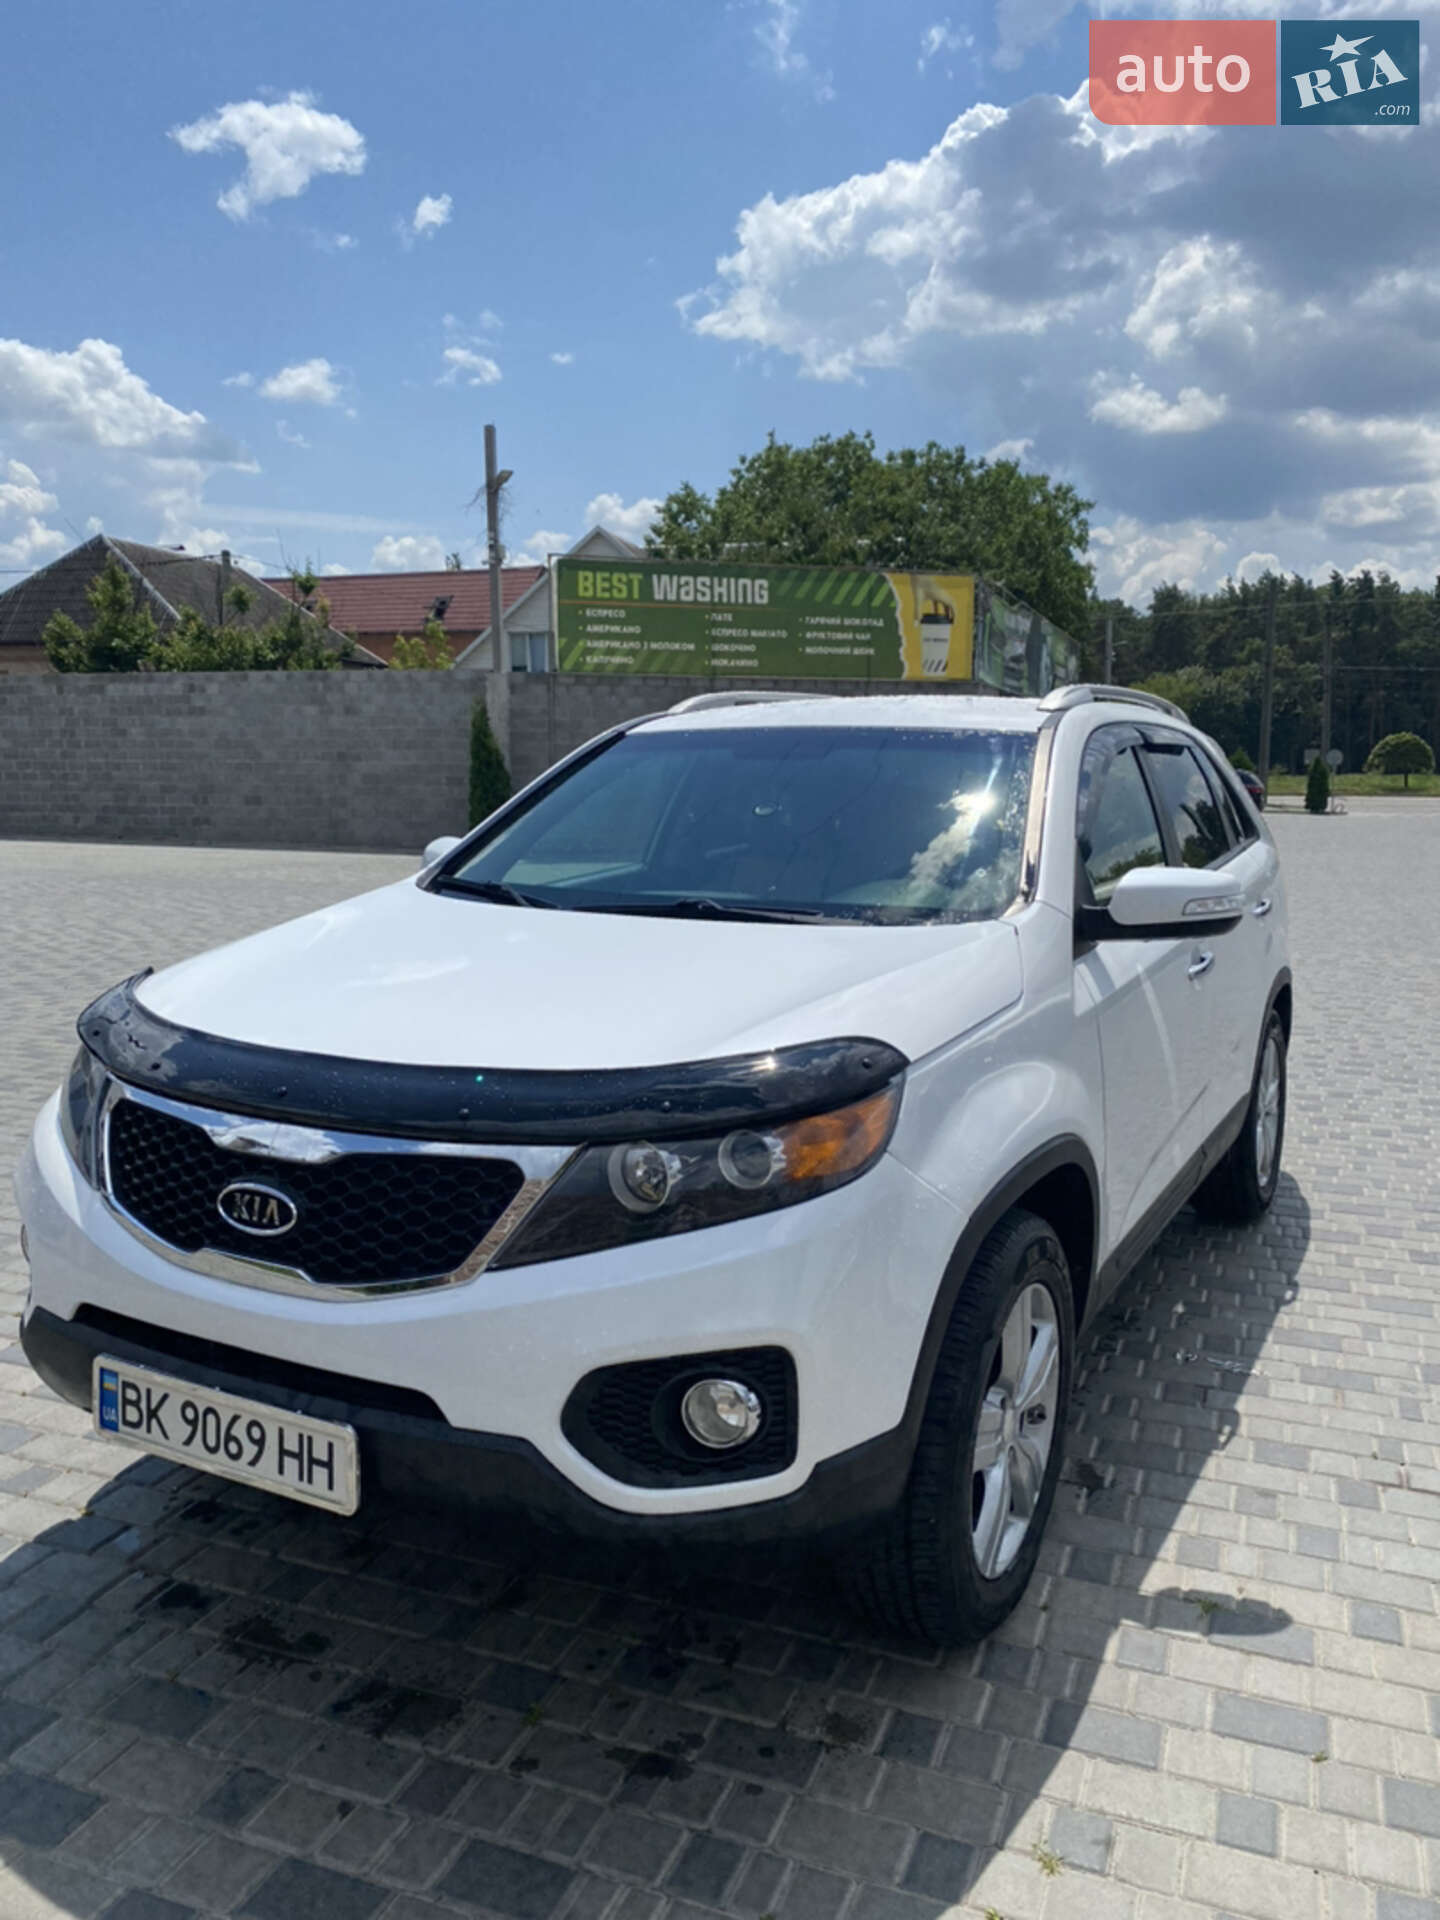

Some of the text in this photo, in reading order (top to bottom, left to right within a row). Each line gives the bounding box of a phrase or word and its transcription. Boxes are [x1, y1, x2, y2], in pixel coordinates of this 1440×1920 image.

[577, 570, 643, 599] BEST
[232, 1192, 280, 1226] KIA
[102, 1405, 118, 1422] UA
[121, 1380, 335, 1491] BK 9069 HH
